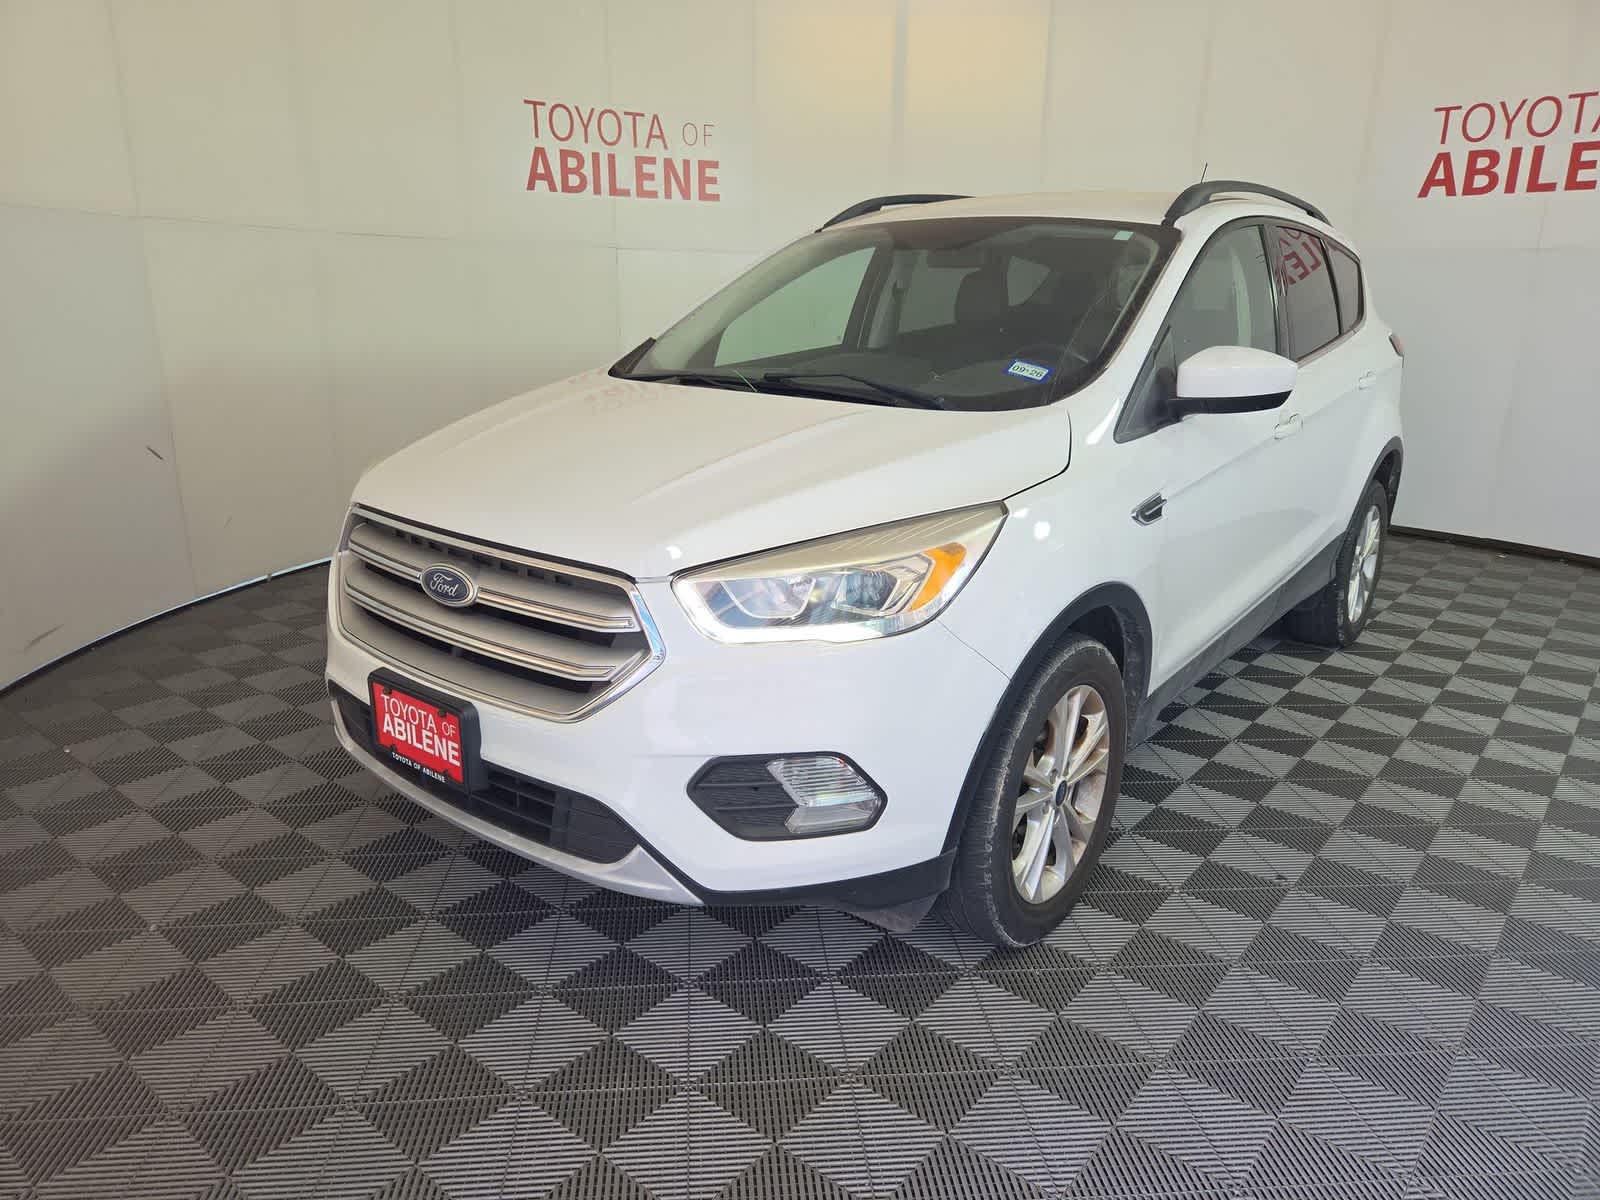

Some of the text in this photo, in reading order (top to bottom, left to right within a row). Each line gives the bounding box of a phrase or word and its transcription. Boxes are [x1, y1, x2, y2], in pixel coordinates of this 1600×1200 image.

[524, 99, 715, 150] TOYOTA OF
[1434, 91, 1600, 145] TOYOT
[526, 146, 721, 202] ABILENE
[430, 573, 459, 597] Ford
[381, 694, 456, 737] TOYOTA OF
[383, 713, 461, 767] ABILENE
[391, 752, 413, 767] TOYOTA
[422, 768, 447, 783] ABILENE
